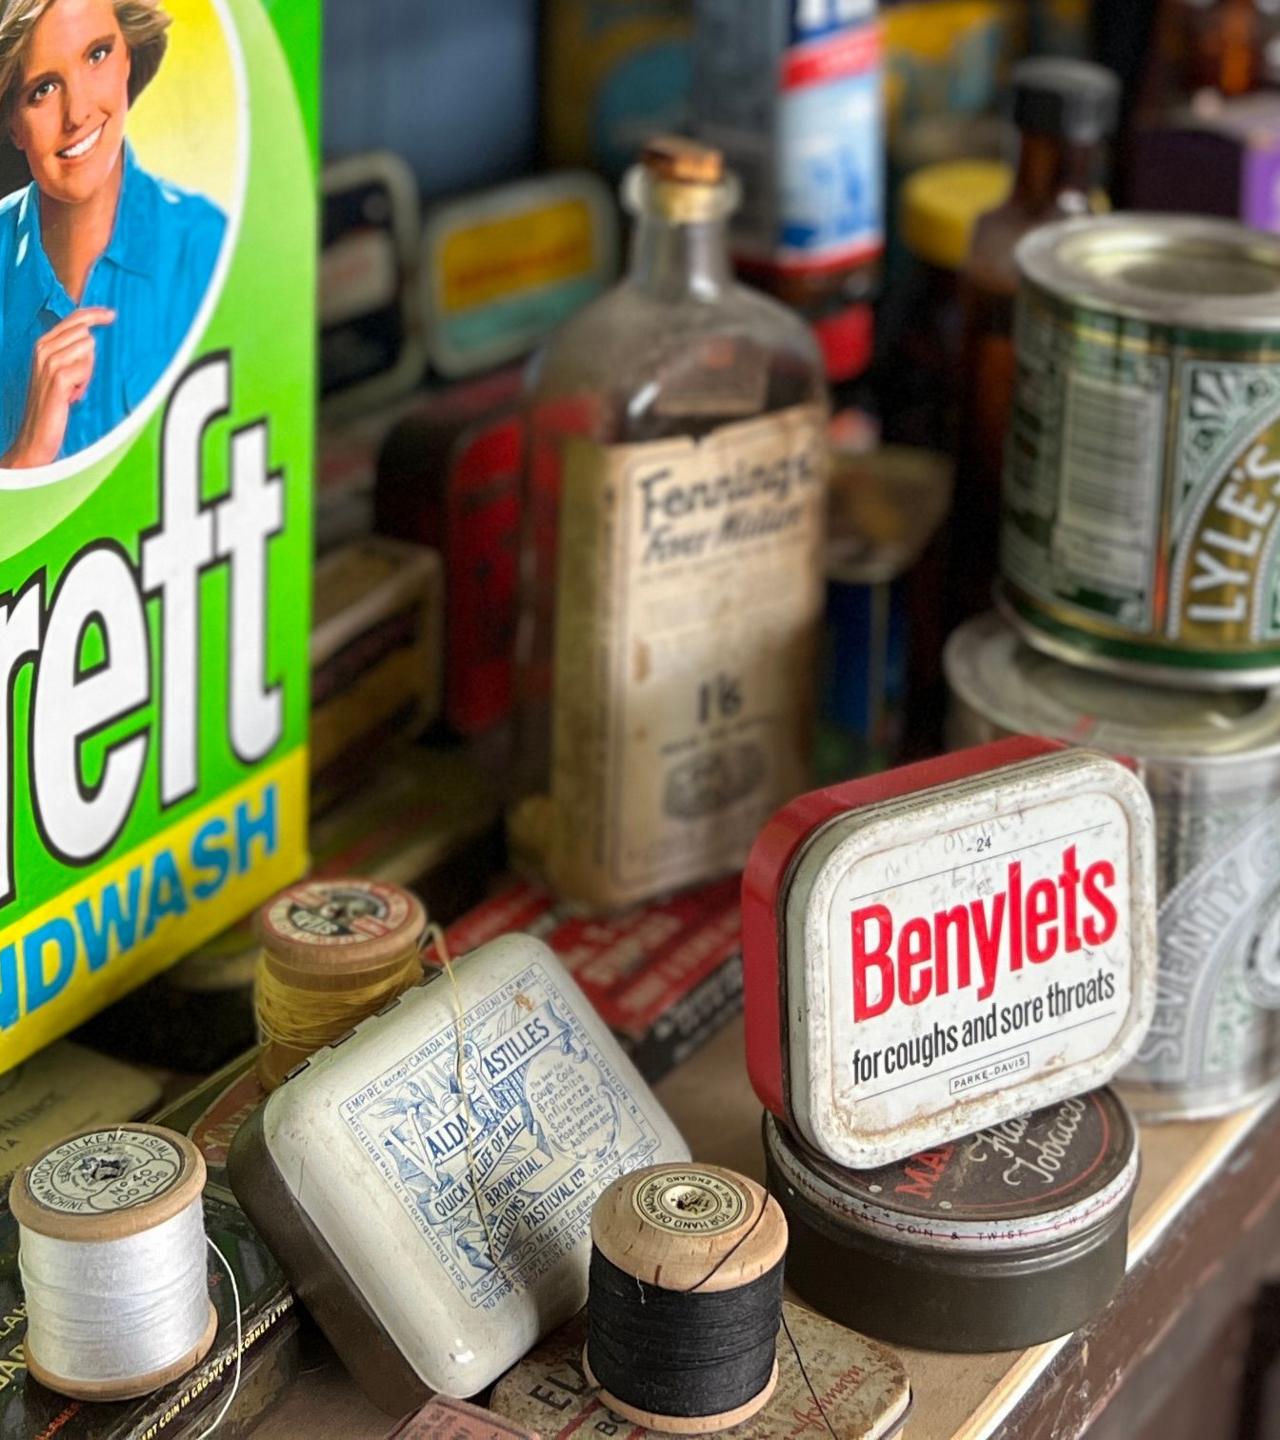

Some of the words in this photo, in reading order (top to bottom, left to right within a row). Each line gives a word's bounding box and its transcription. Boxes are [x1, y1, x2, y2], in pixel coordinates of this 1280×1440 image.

[851, 842, 1119, 1025] Benylets
[851, 1047, 883, 1086] for
[882, 1021, 960, 1076] coughs
[961, 1002, 998, 1048] and
[999, 995, 1044, 1037] sore
[1046, 967, 1116, 1017] throats
[953, 1056, 1027, 1090] PARKE-DAVIS
[345, 1082, 383, 1114] EMPIRE
[529, 1078, 556, 1105] Cough
[550, 1115, 573, 1134] Sore
[1002, 1096, 1086, 1187] Tobacco
[55, 1131, 130, 1157] SILKENE
[137, 1134, 171, 1161] TWIST
[433, 1184, 469, 1218] QUICK
[502, 1115, 523, 1139] ALL
[484, 1156, 543, 1209] BRONCHIAL
[522, 1179, 576, 1231] PASTILVAL
[827, 1196, 879, 1225] INSERT
[895, 1221, 934, 1239] COIN
[672, 1216, 715, 1230] HAND
[158, 1404, 181, 1429] COIN
